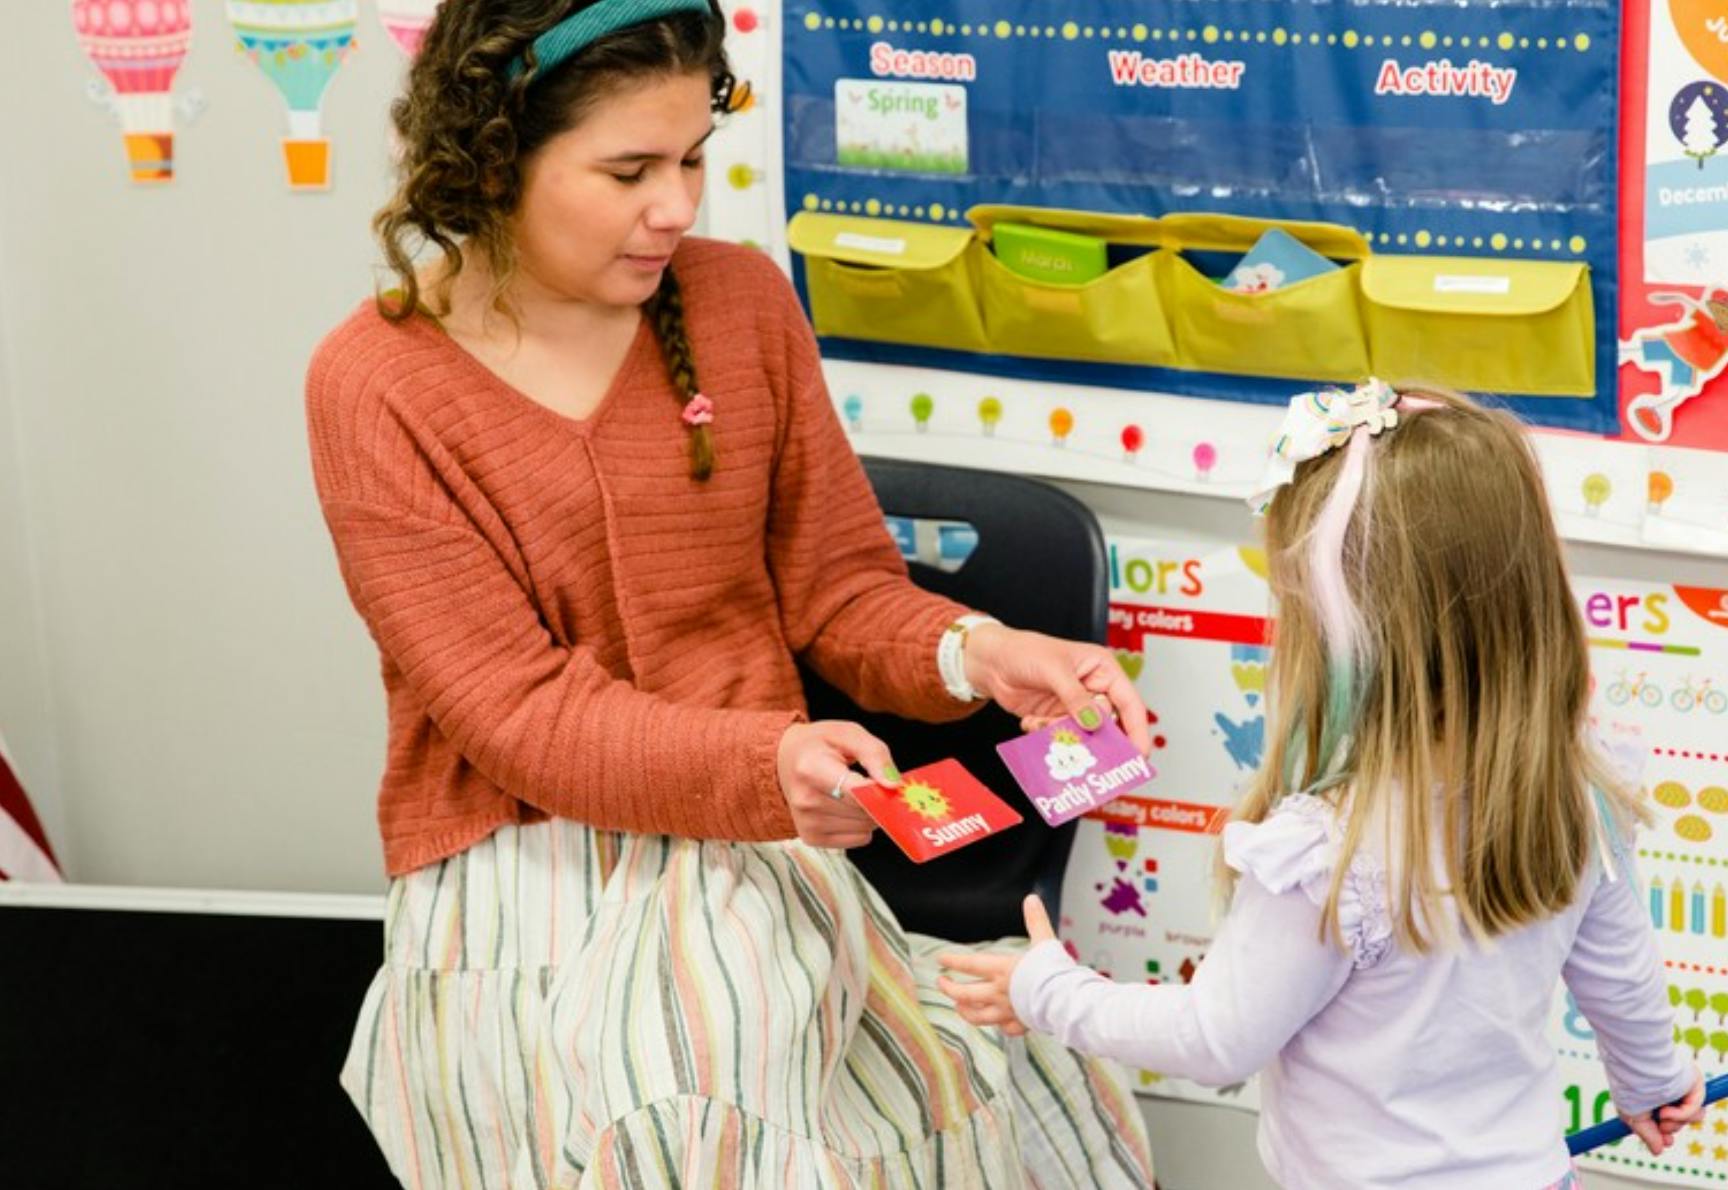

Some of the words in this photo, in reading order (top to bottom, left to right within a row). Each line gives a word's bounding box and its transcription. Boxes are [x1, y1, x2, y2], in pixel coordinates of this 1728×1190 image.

[870, 41, 977, 81] Season
[1108, 49, 1245, 88] Weather
[1375, 59, 1517, 103] Activity
[867, 88, 938, 119] Spring
[1658, 184, 1728, 207] Decem
[1110, 544, 1204, 597] lors
[1137, 609, 1194, 633] colors
[1586, 592, 1670, 635] ers
[1034, 782, 1096, 819] Partly
[1086, 754, 1150, 794] Sunny
[922, 812, 990, 847] Sunny
[1150, 802, 1206, 827] colors
